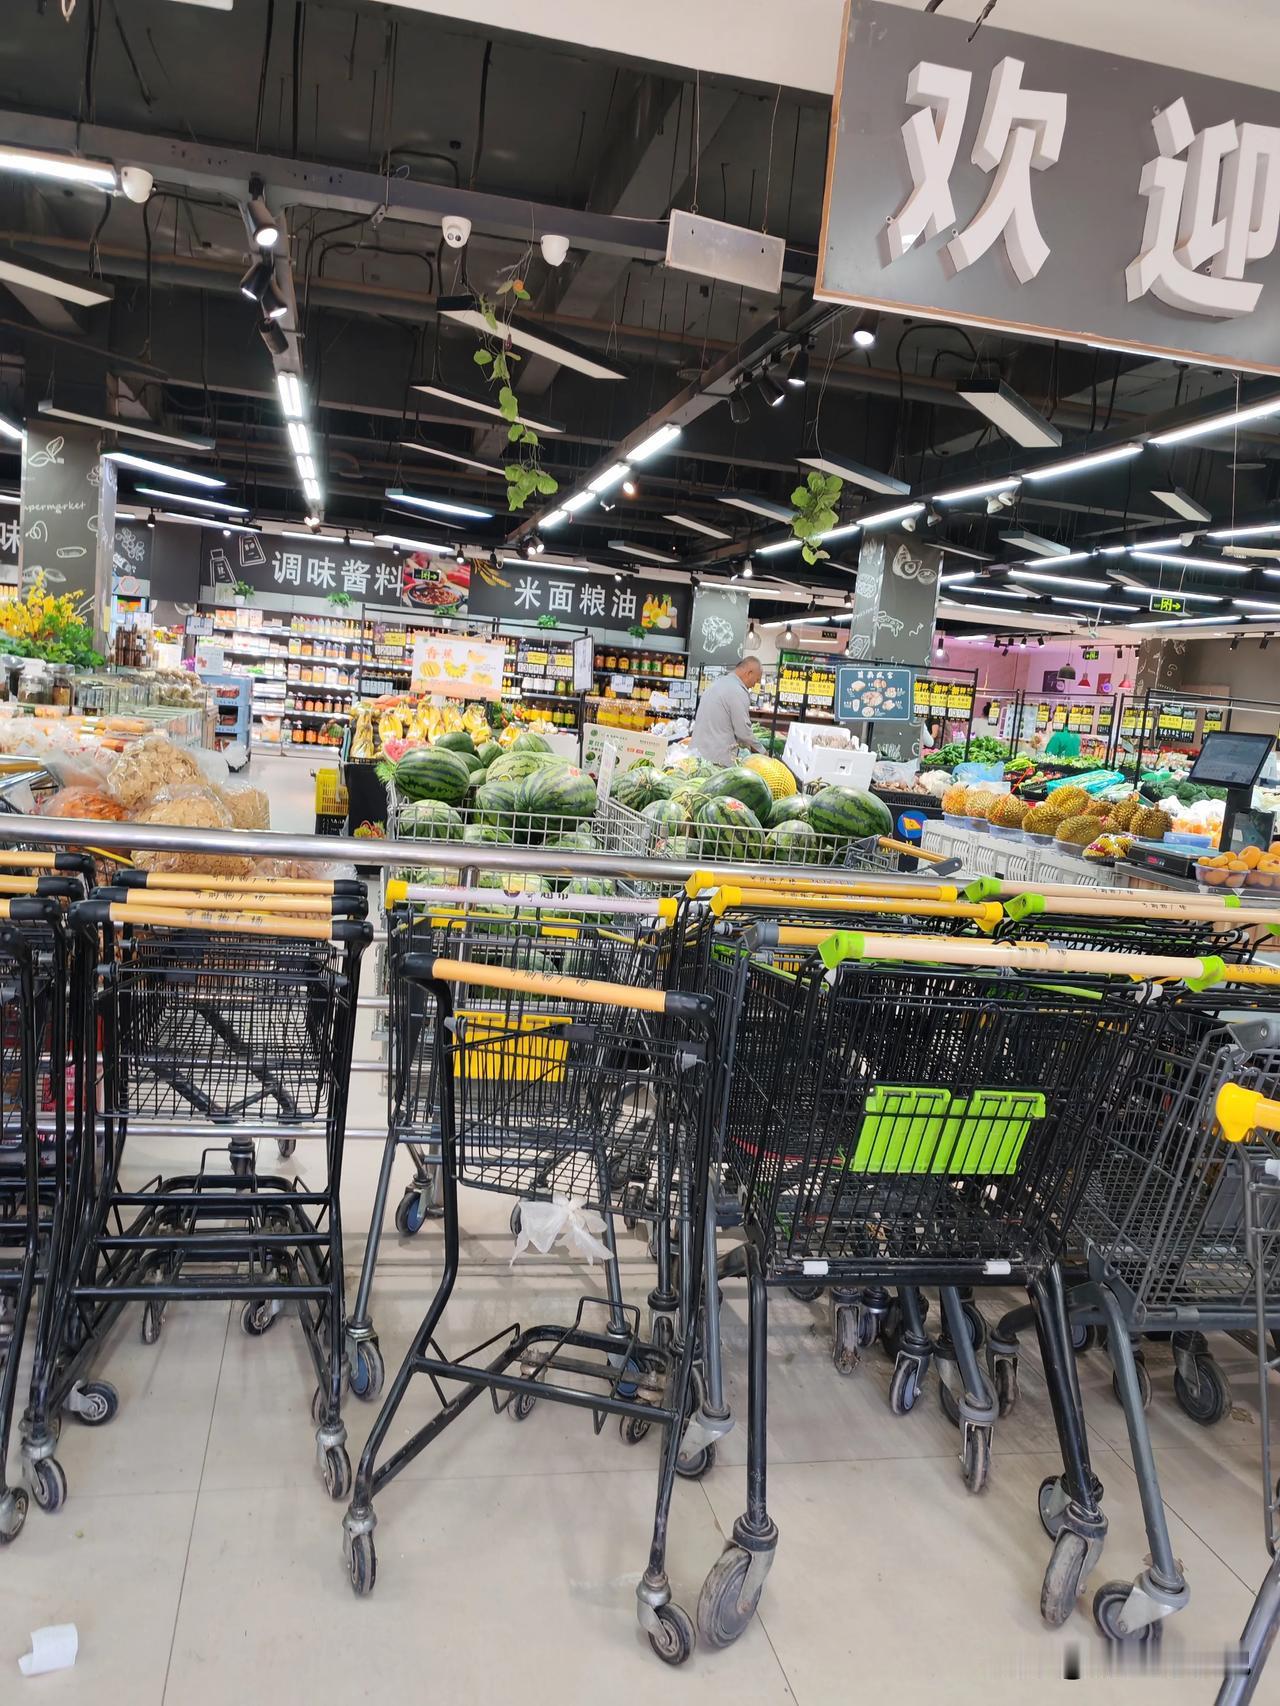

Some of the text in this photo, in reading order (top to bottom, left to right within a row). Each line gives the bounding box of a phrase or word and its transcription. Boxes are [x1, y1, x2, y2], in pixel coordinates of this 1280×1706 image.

[886, 55, 1280, 318] 欢迎
[271, 550, 404, 597] 调味酱料
[513, 575, 637, 620] 米面粮油
